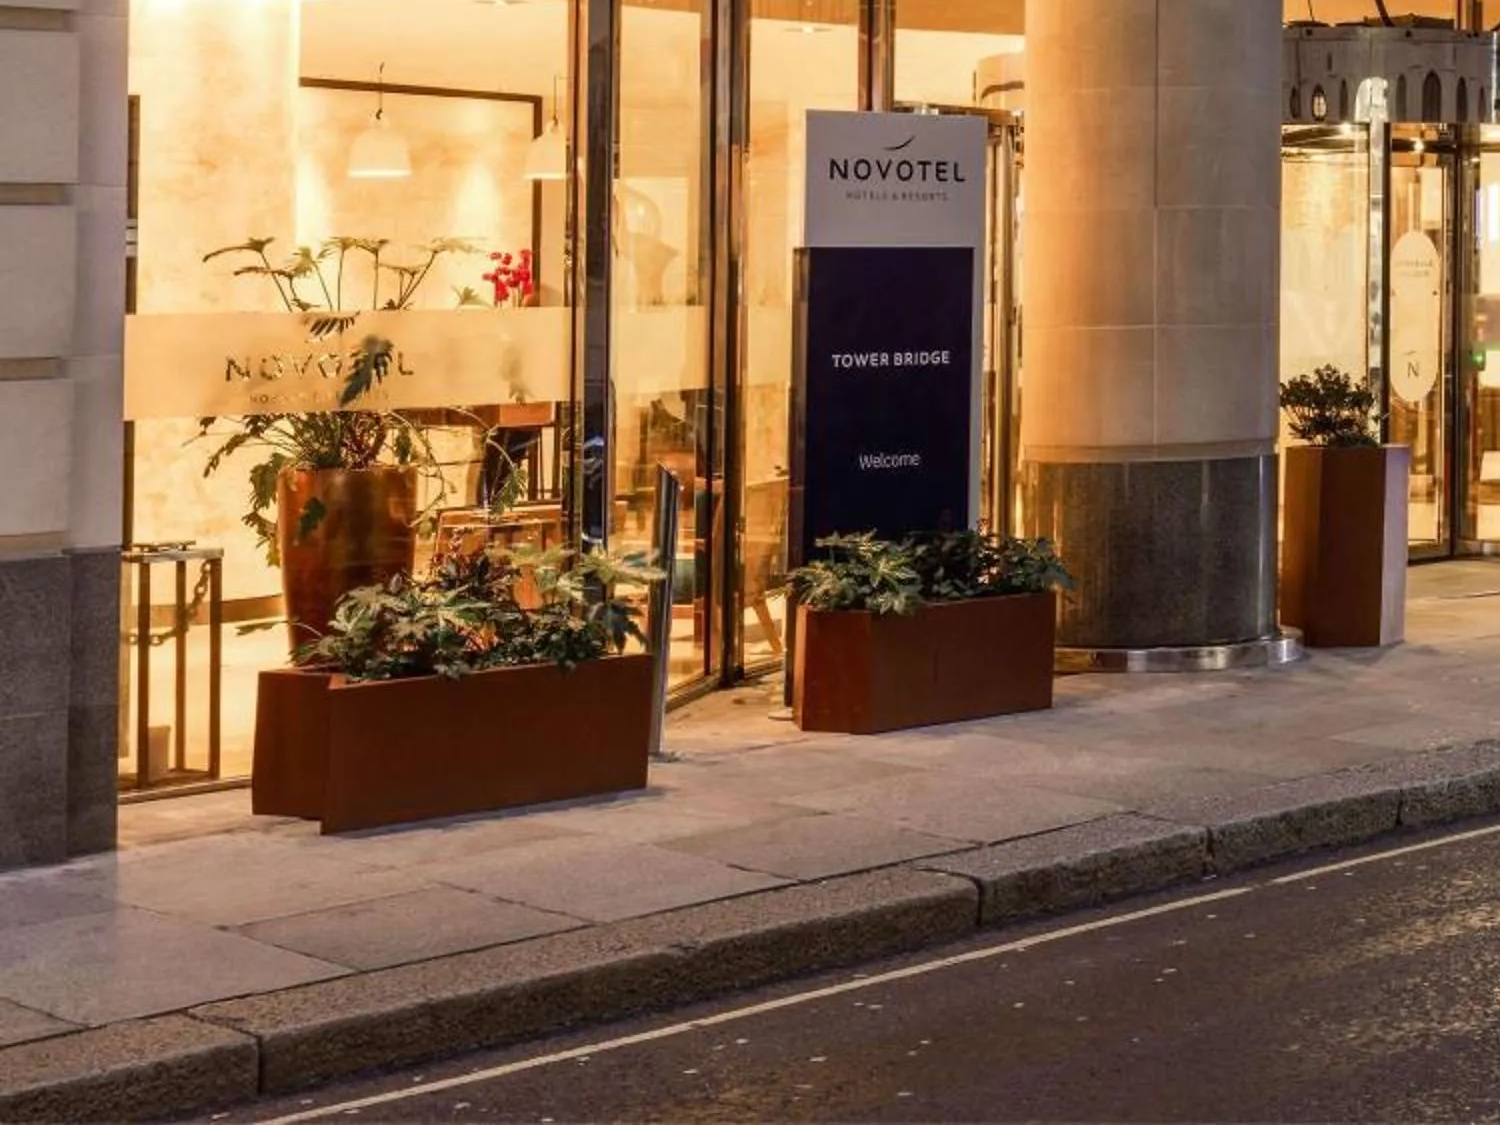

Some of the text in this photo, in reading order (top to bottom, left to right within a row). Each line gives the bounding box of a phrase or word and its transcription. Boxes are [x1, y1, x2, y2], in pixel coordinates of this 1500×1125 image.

[829, 158, 966, 183] NOVOTEL
[225, 351, 414, 382] NOVOL
[831, 350, 951, 368] TOWER BRIDGE
[859, 453, 921, 470] Welcome
